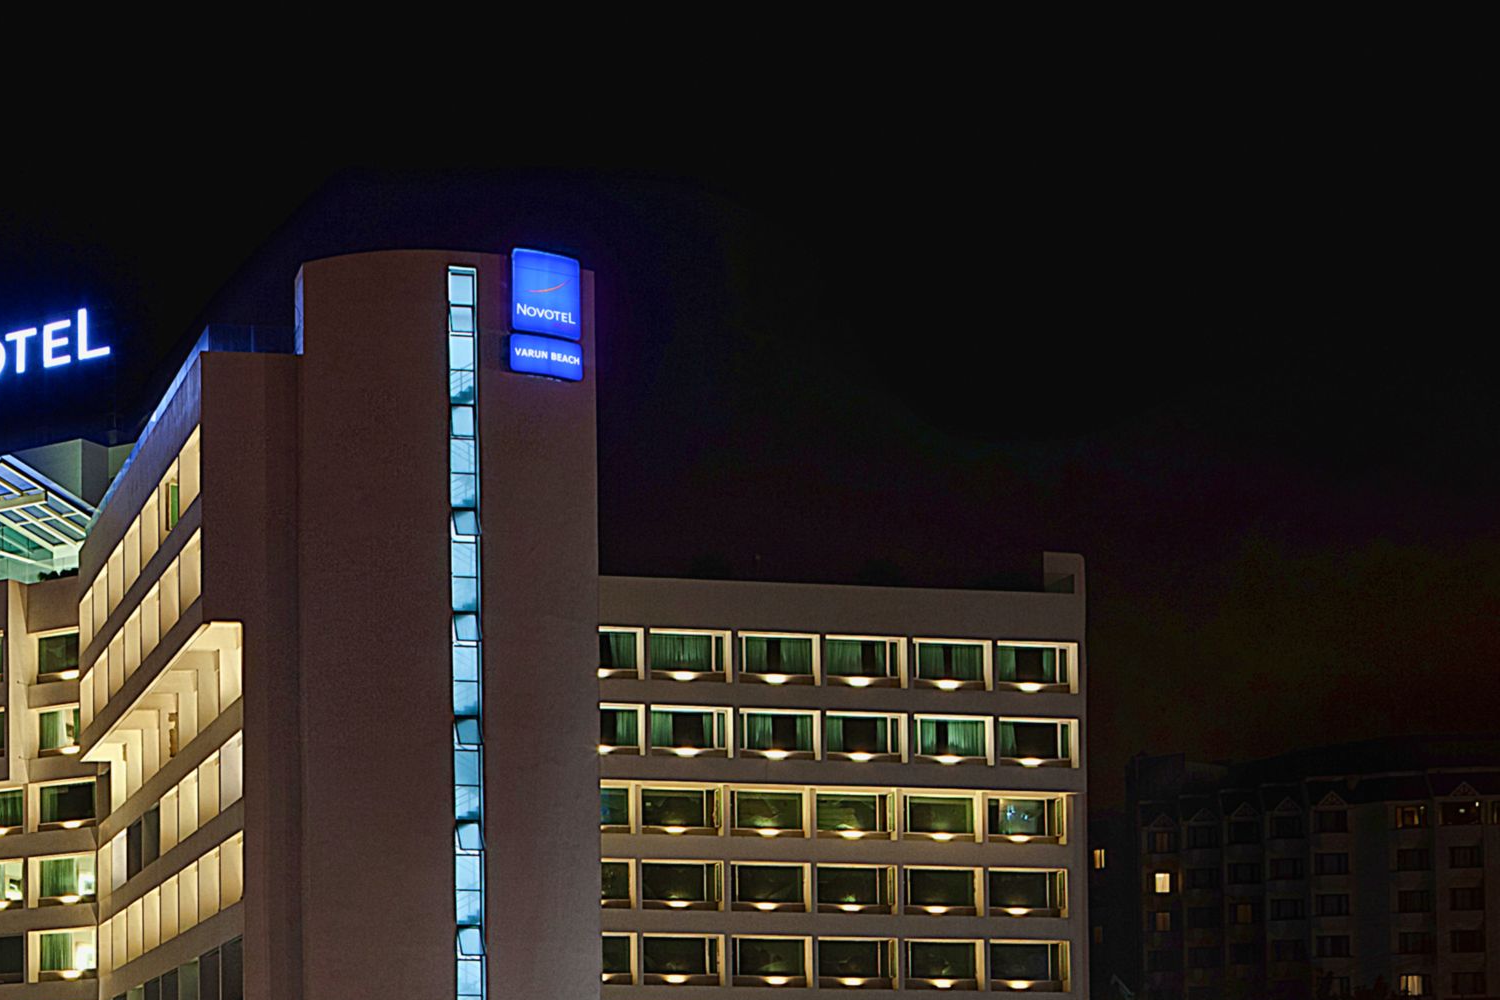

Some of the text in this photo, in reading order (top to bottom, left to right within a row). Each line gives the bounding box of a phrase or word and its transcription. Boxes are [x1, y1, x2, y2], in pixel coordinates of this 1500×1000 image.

[516, 303, 576, 325] NOVOTEL
[514, 347, 581, 366] VARUN BEACH
